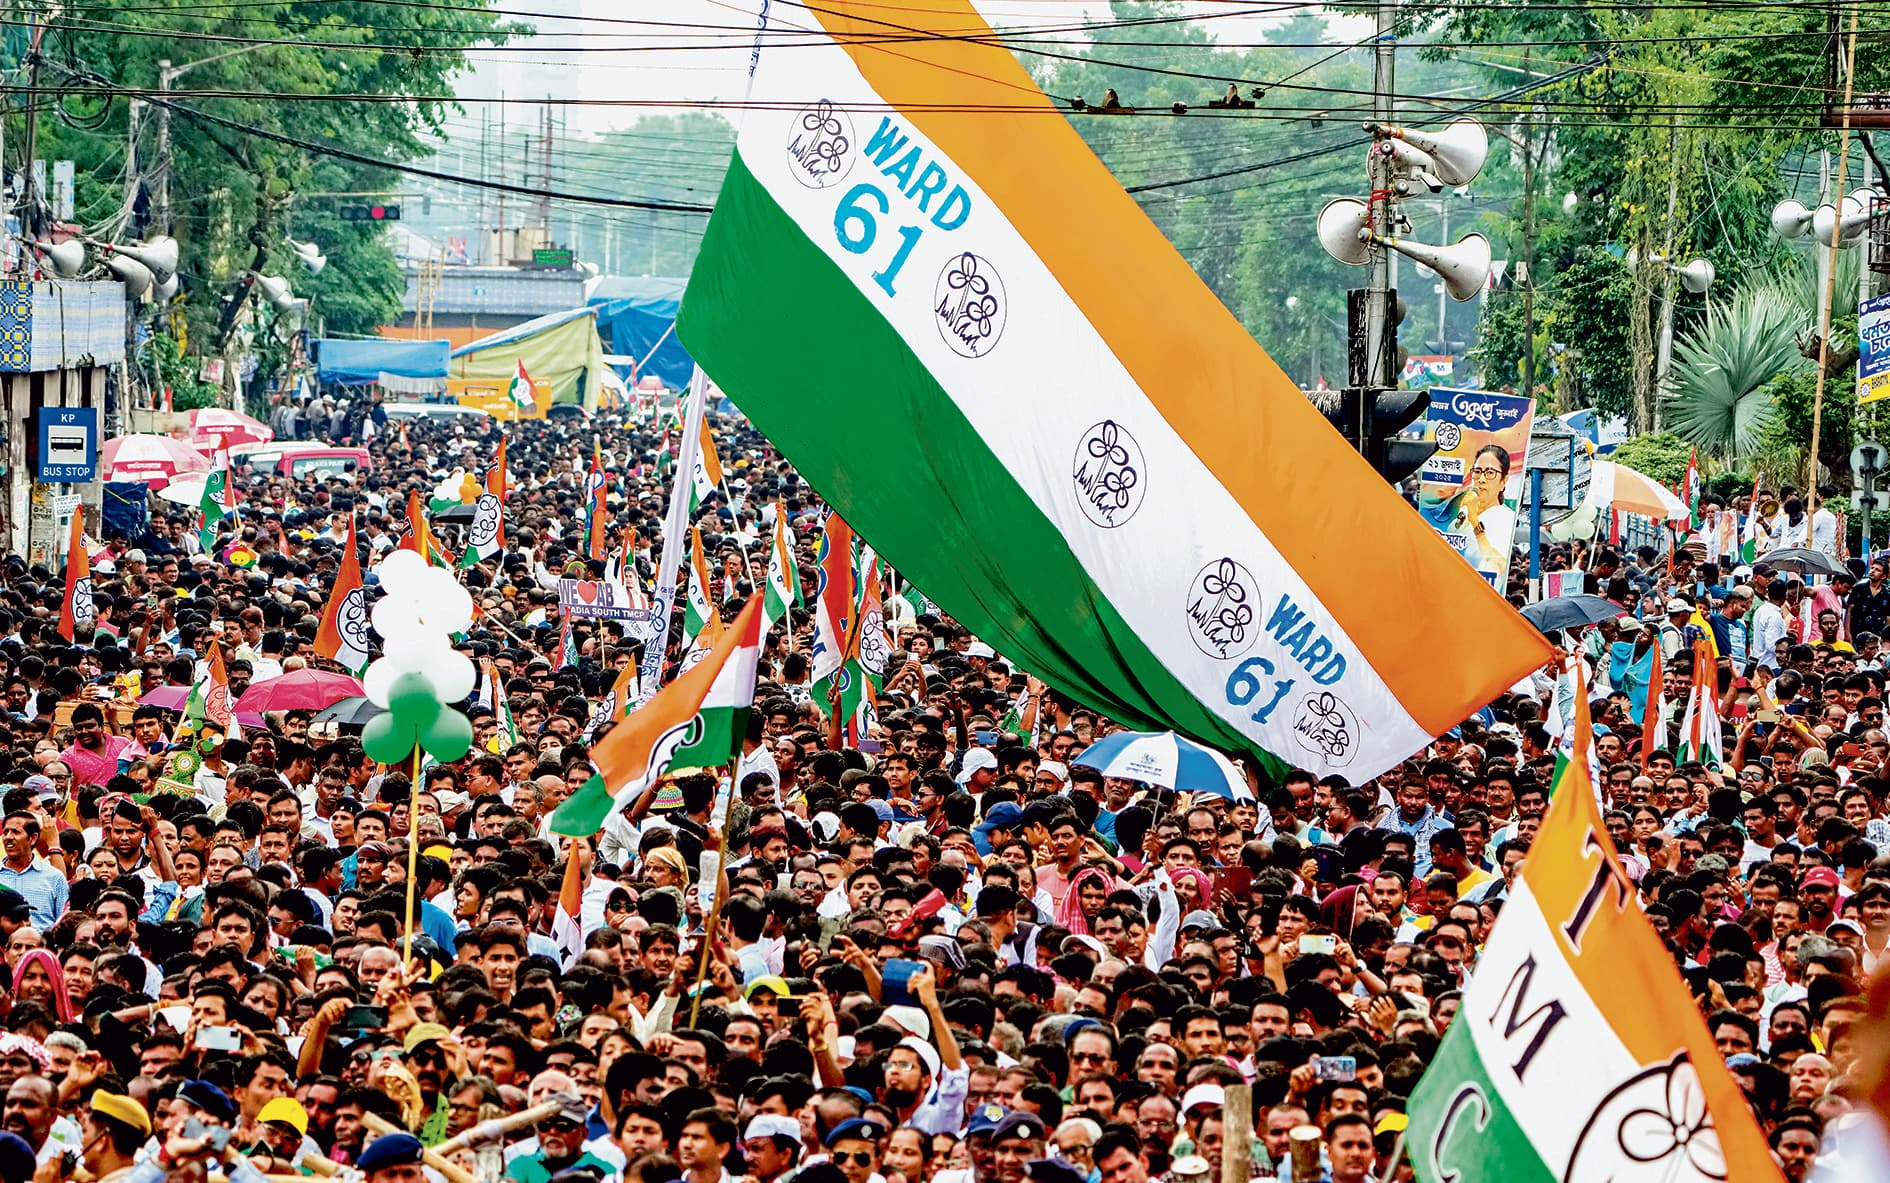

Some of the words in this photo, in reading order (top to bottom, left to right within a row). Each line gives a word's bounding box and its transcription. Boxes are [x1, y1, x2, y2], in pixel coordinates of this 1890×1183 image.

[863, 115, 972, 231] WARD
[833, 183, 924, 298] 61
[61, 413, 76, 423] KP
[43, 466, 62, 477] BUS
[66, 466, 90, 477] STOP
[1428, 459, 1439, 469] ২১
[1440, 459, 1462, 472] জুলাই
[560, 579, 578, 605] WE
[597, 582, 615, 607] AB
[592, 607, 620, 617] SOUTH
[623, 608, 645, 618] TMCP
[1265, 593, 1347, 685] WARD
[1226, 657, 1296, 724] 61
[1489, 949, 1570, 1085] M
